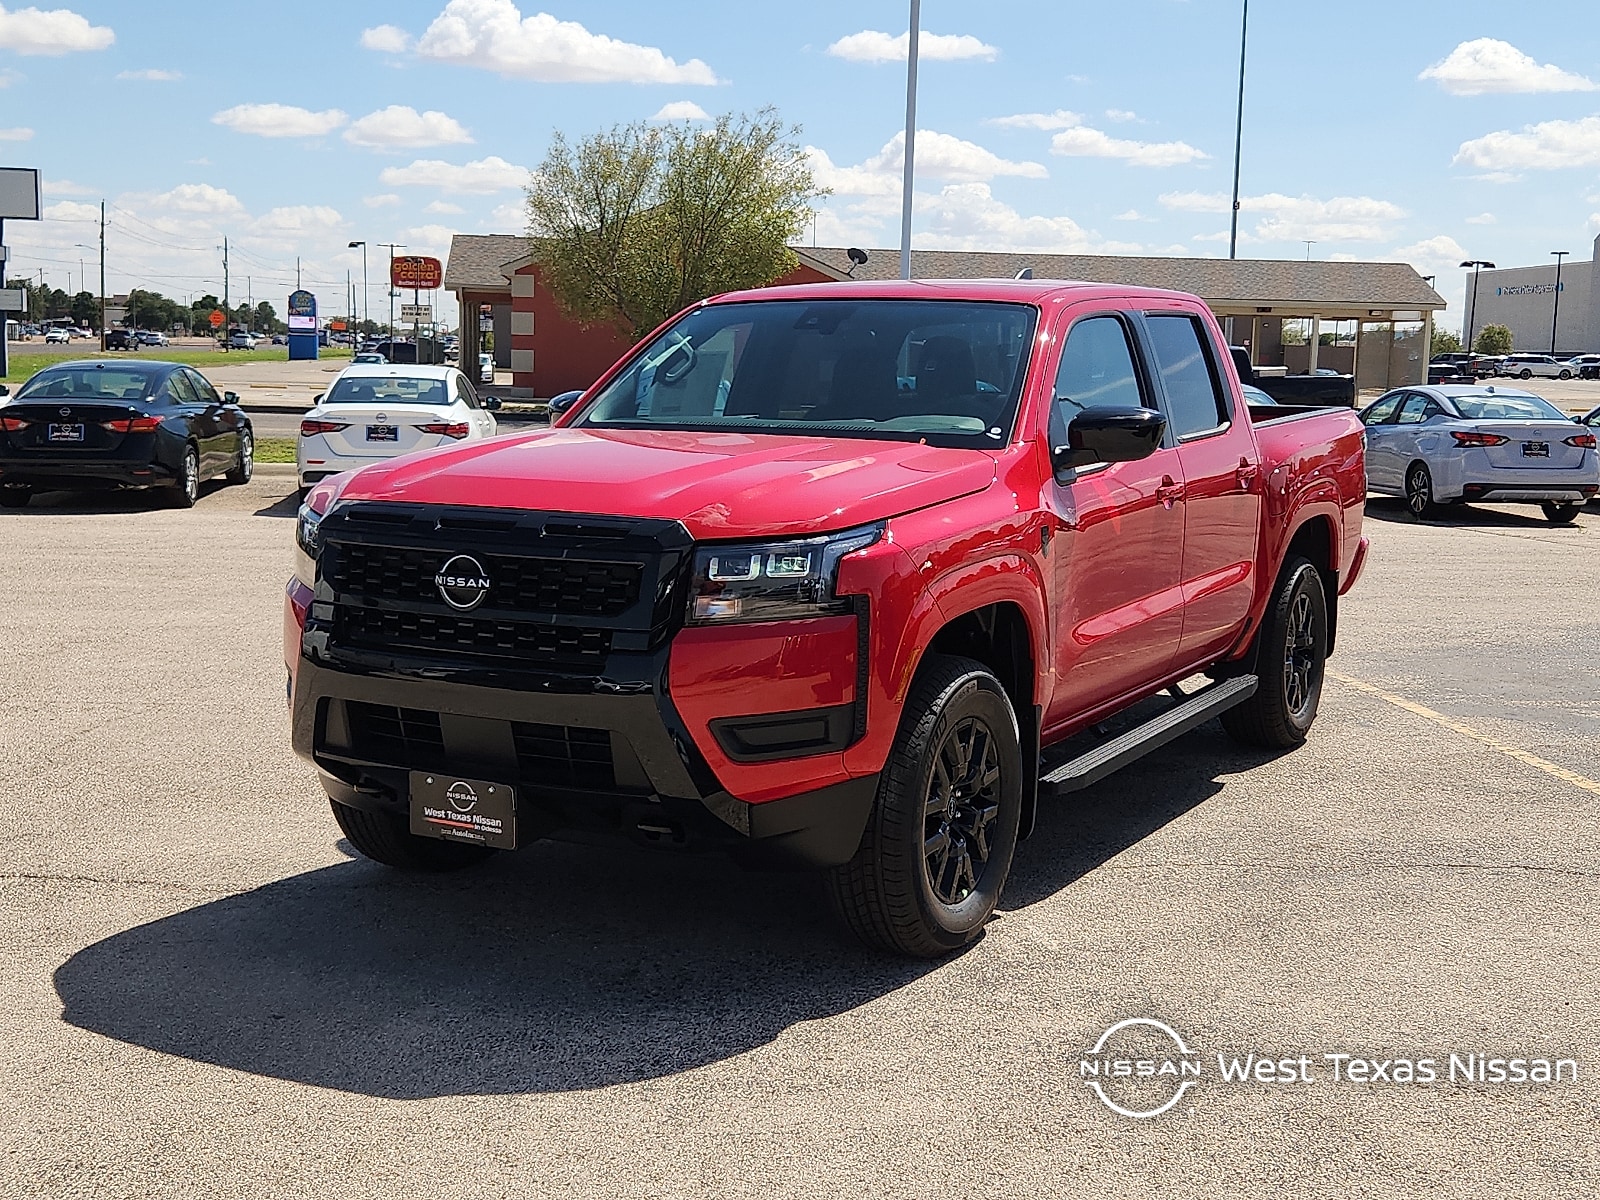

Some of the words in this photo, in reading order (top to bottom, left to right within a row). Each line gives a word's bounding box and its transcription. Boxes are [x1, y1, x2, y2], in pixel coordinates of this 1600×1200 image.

[394, 263, 434, 272] golden
[401, 271, 438, 279] corral
[435, 575, 490, 588] NISSAN
[446, 791, 478, 802] NISSAN
[424, 807, 446, 818] West
[447, 811, 471, 822] Texas
[473, 815, 502, 827] Nissan
[481, 825, 502, 834] Odessa
